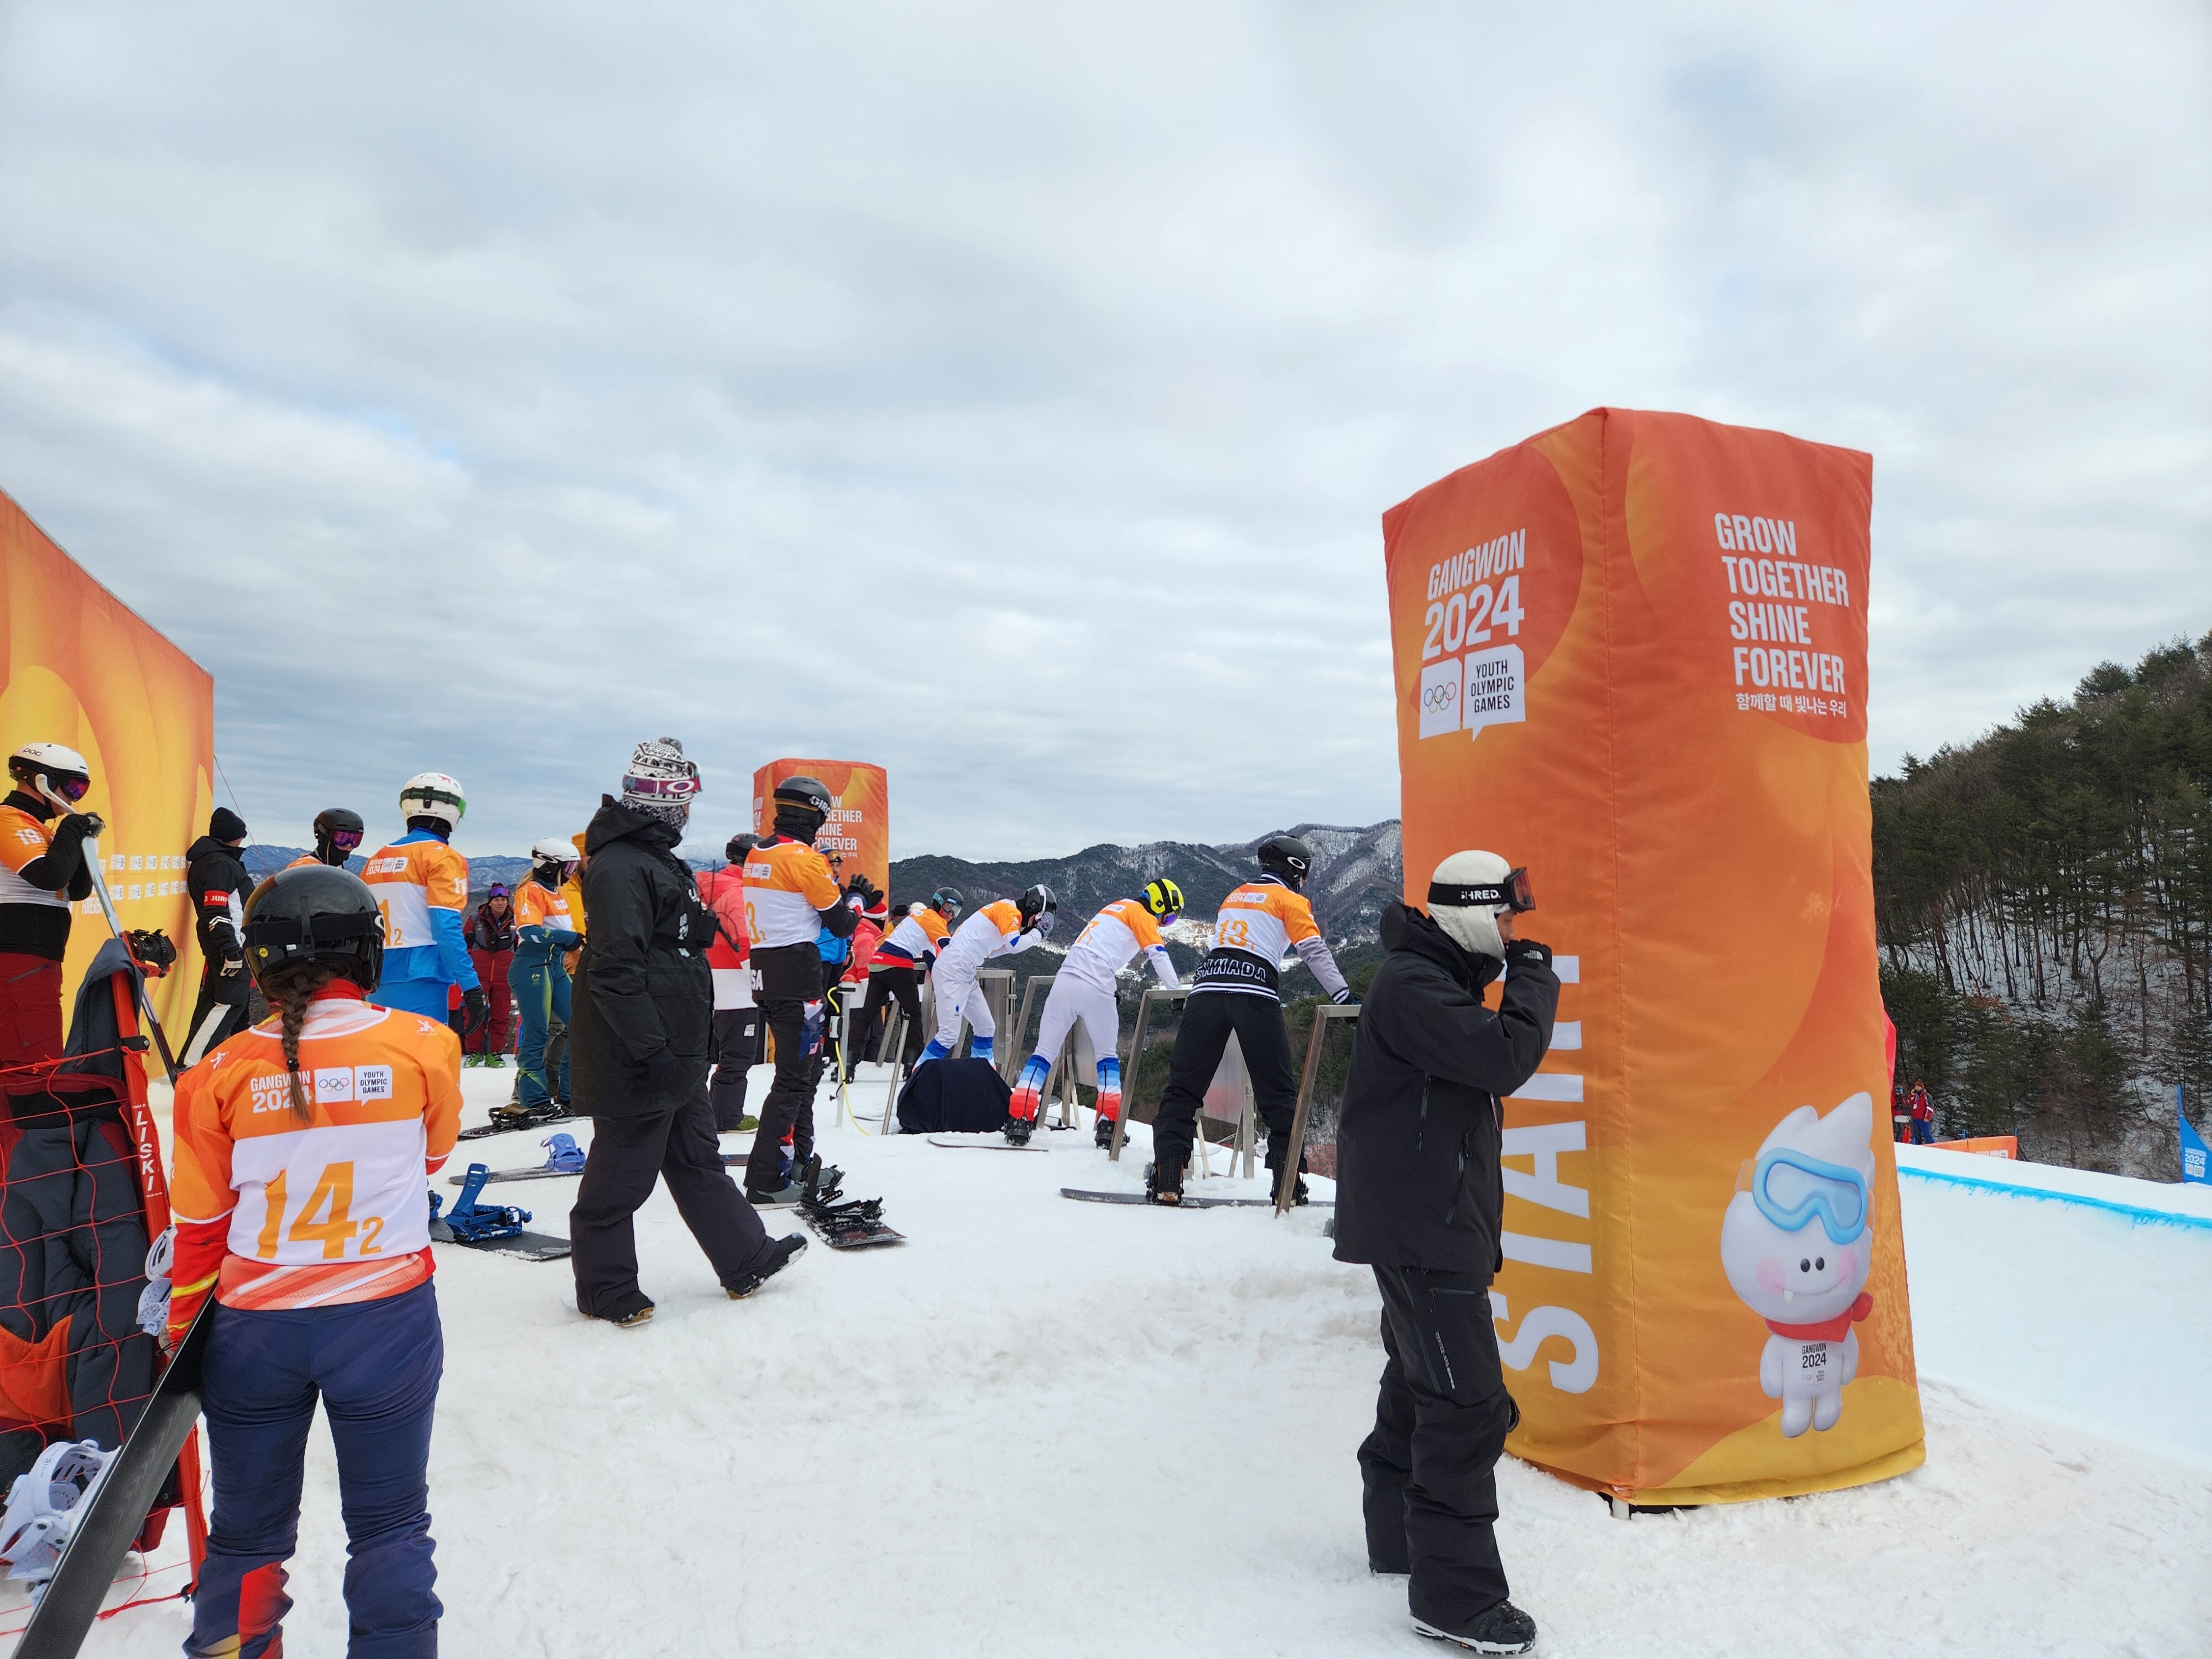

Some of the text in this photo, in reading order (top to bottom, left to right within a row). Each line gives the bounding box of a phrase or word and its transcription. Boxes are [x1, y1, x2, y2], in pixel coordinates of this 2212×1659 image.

[1714, 513, 1797, 556] GROW
[1427, 528, 1526, 601] GANGWON
[1721, 556, 1849, 607] TOGETHER
[1422, 575, 1525, 660] 2024
[1729, 601, 1812, 645] SHINE
[1476, 659, 1507, 679] YOUTH
[1733, 646, 1845, 695] FOREVER
[1471, 676, 1514, 696] OLYMPIC
[1474, 694, 1510, 713] GAMES
[1736, 692, 1846, 718] 함께할 때 빛나는 우리
[826, 810, 863, 823] GETHER
[816, 823, 843, 836] HINE
[1218, 919, 1248, 948] 13
[751, 969, 764, 990] SA
[360, 1078, 387, 1087] OLYMPIC
[136, 1110, 155, 1192] LISKI
[2185, 1154, 2205, 1166] 2024
[256, 1161, 384, 1260] 14 2
[1802, 1342, 1827, 1355] GANGWON
[1802, 1352, 1827, 1369] 2024
